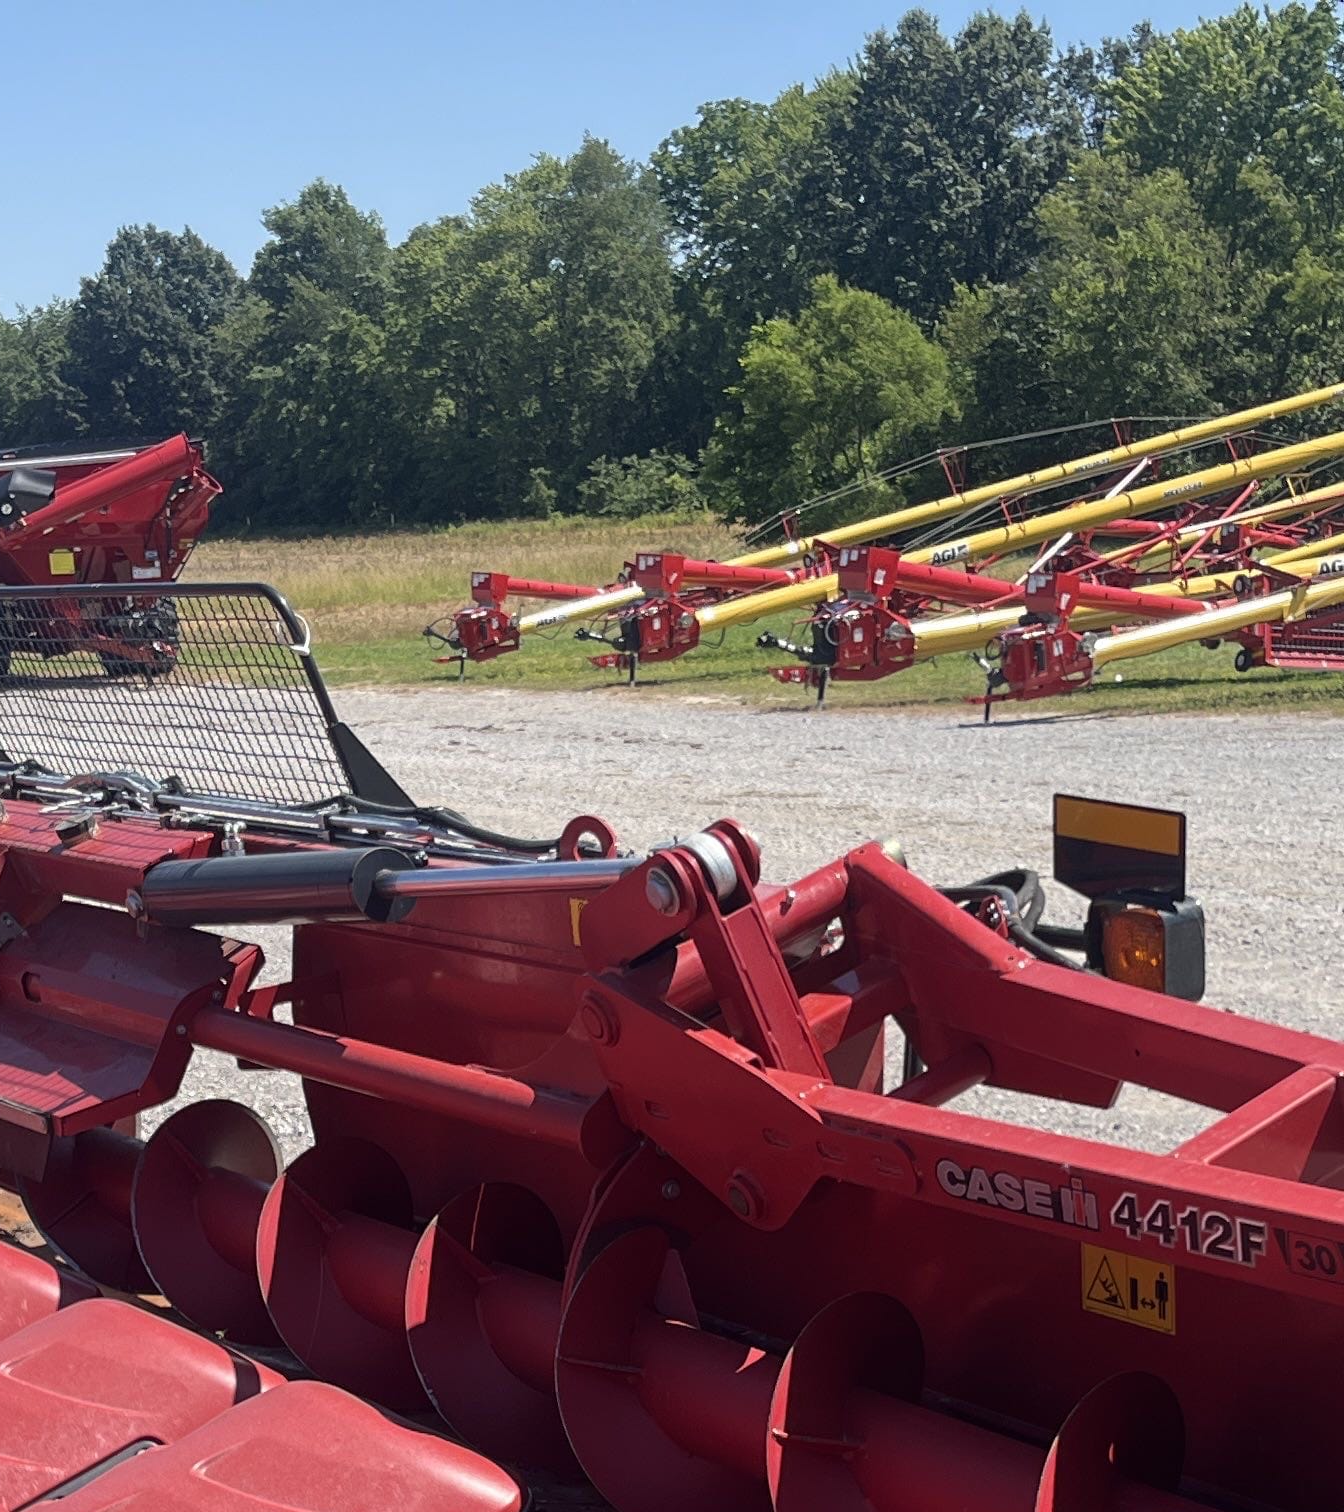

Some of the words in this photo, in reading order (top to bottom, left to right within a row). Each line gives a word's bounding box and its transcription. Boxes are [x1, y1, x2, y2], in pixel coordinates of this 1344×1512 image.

[936, 1159, 1055, 1219] CASE
[1111, 1192, 1267, 1268] 4412F
[1294, 1242, 1338, 1276] 30
